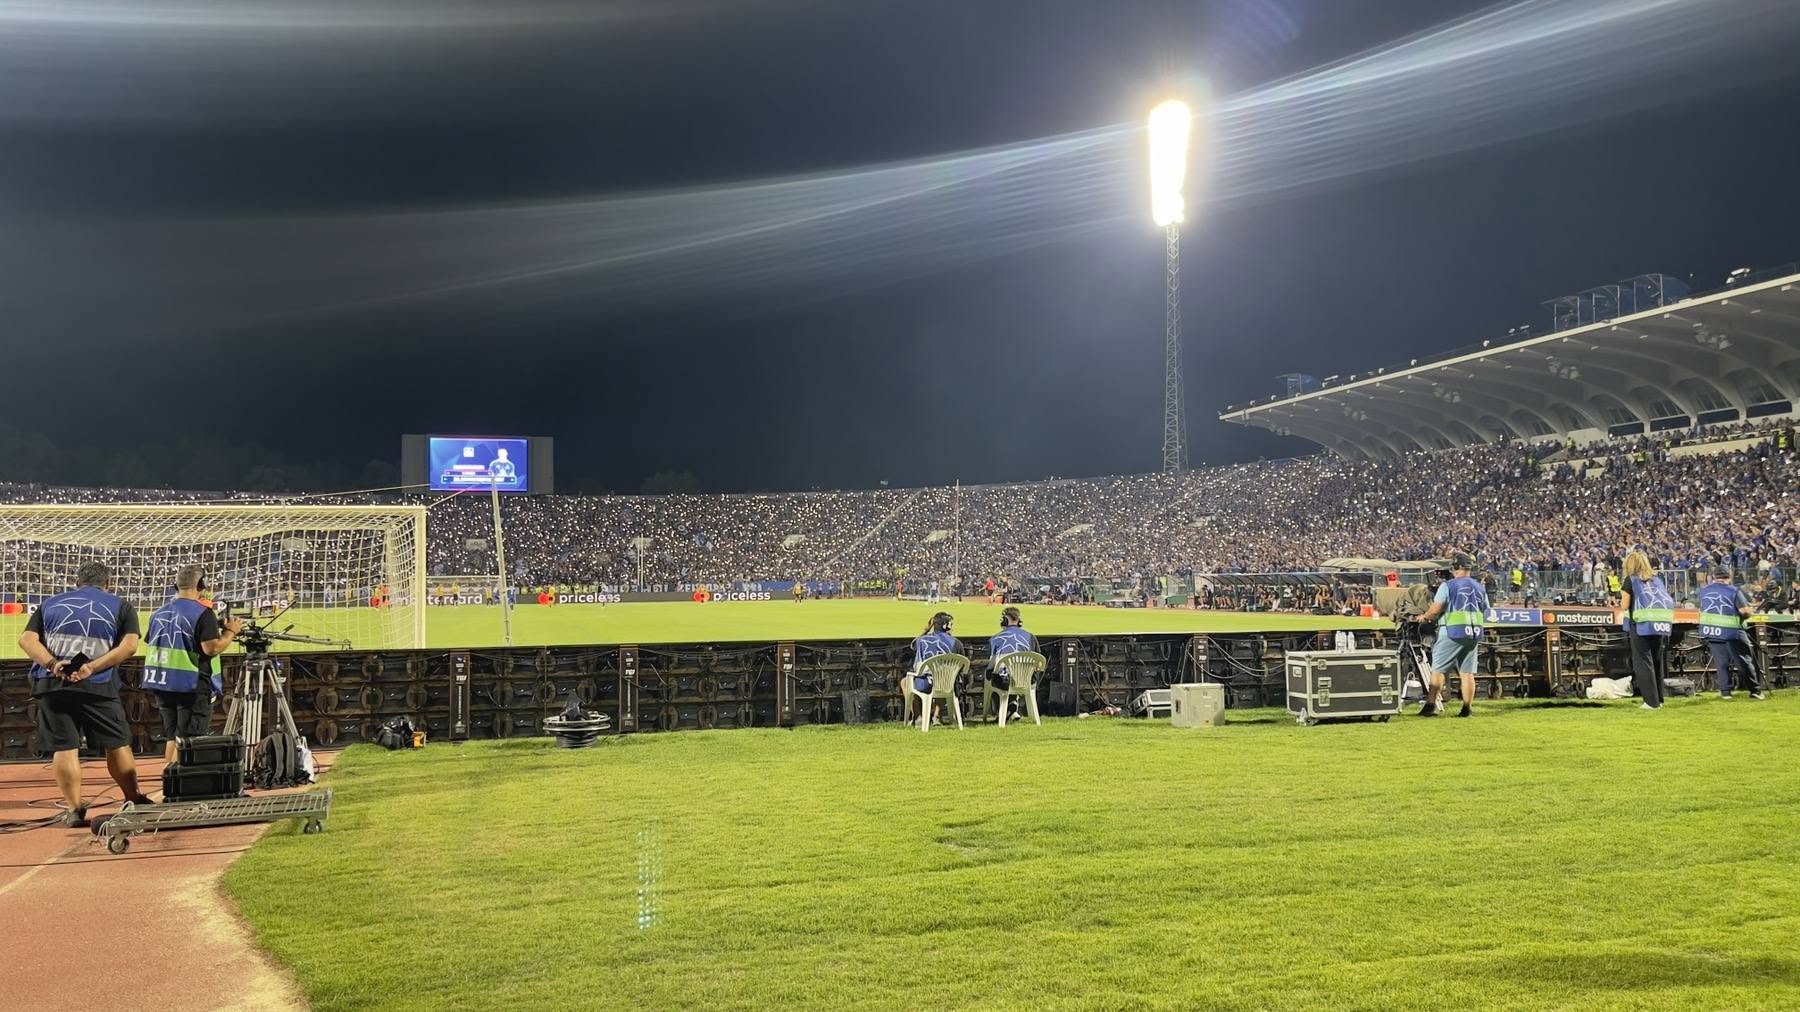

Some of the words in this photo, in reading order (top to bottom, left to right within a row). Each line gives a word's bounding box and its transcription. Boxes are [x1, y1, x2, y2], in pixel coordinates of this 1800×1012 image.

[1501, 611, 1531, 621] PS5
[1556, 611, 1614, 624] mastercard
[1653, 622, 1671, 633] 008
[1702, 626, 1722, 637] 010
